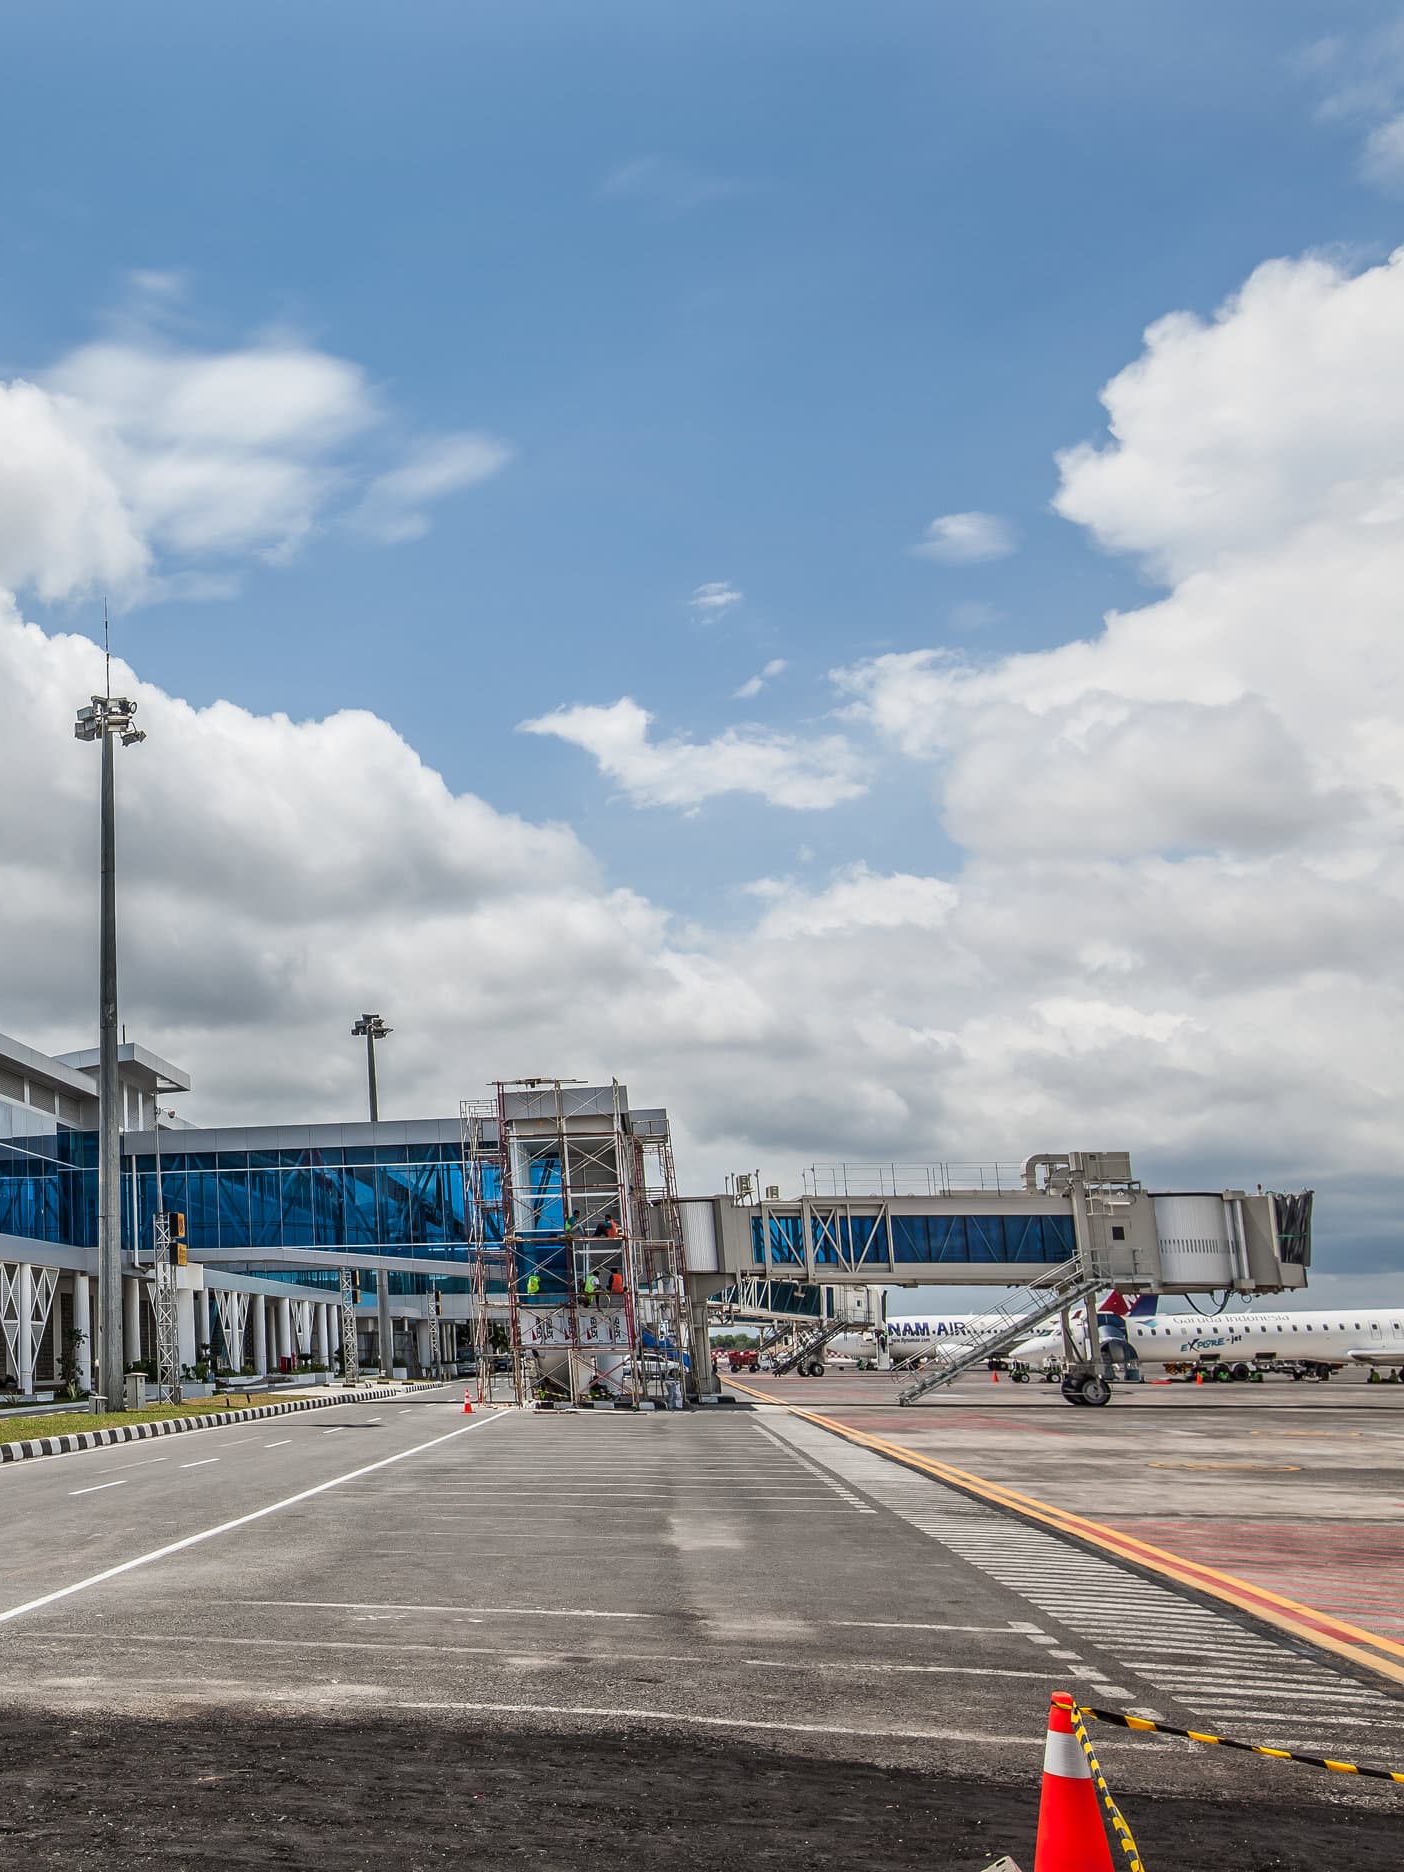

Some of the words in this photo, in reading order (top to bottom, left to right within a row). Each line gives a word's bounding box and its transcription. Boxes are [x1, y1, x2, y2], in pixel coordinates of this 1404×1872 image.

[1225, 1314, 1290, 1323] Indonesia
[887, 1322, 930, 1336] NAM
[937, 1321, 967, 1336] AIR
